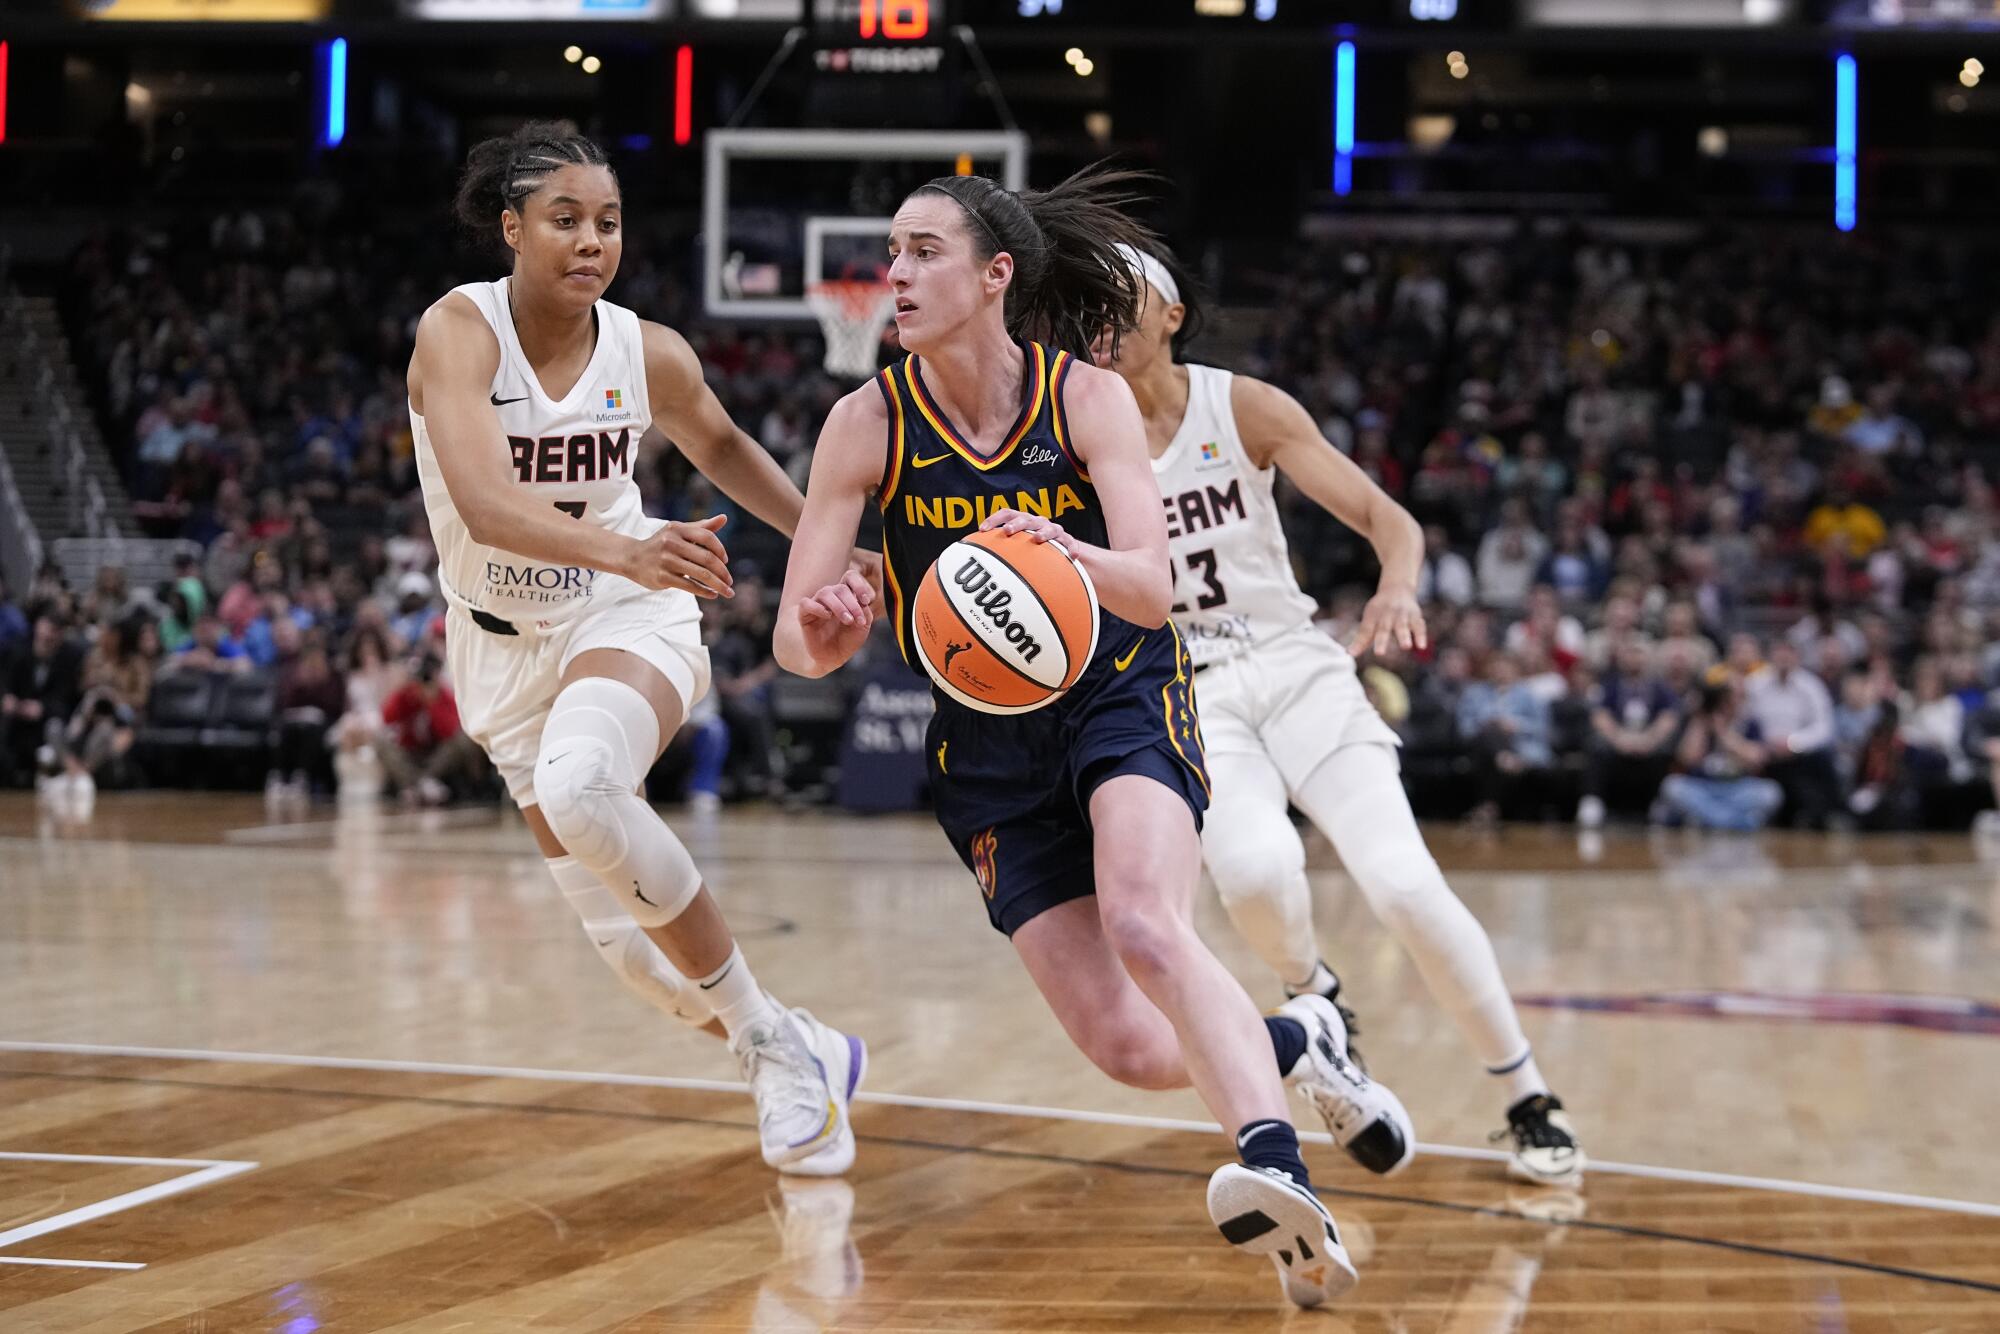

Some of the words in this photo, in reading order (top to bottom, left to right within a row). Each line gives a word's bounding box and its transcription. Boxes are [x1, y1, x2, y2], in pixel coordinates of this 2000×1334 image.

[596, 412, 631, 422] Microsoft
[1022, 444, 1059, 466] Lilly
[904, 484, 1086, 529] INDIANA
[485, 583, 593, 603] HEALTHCARE
[953, 556, 1042, 665] Wilson
